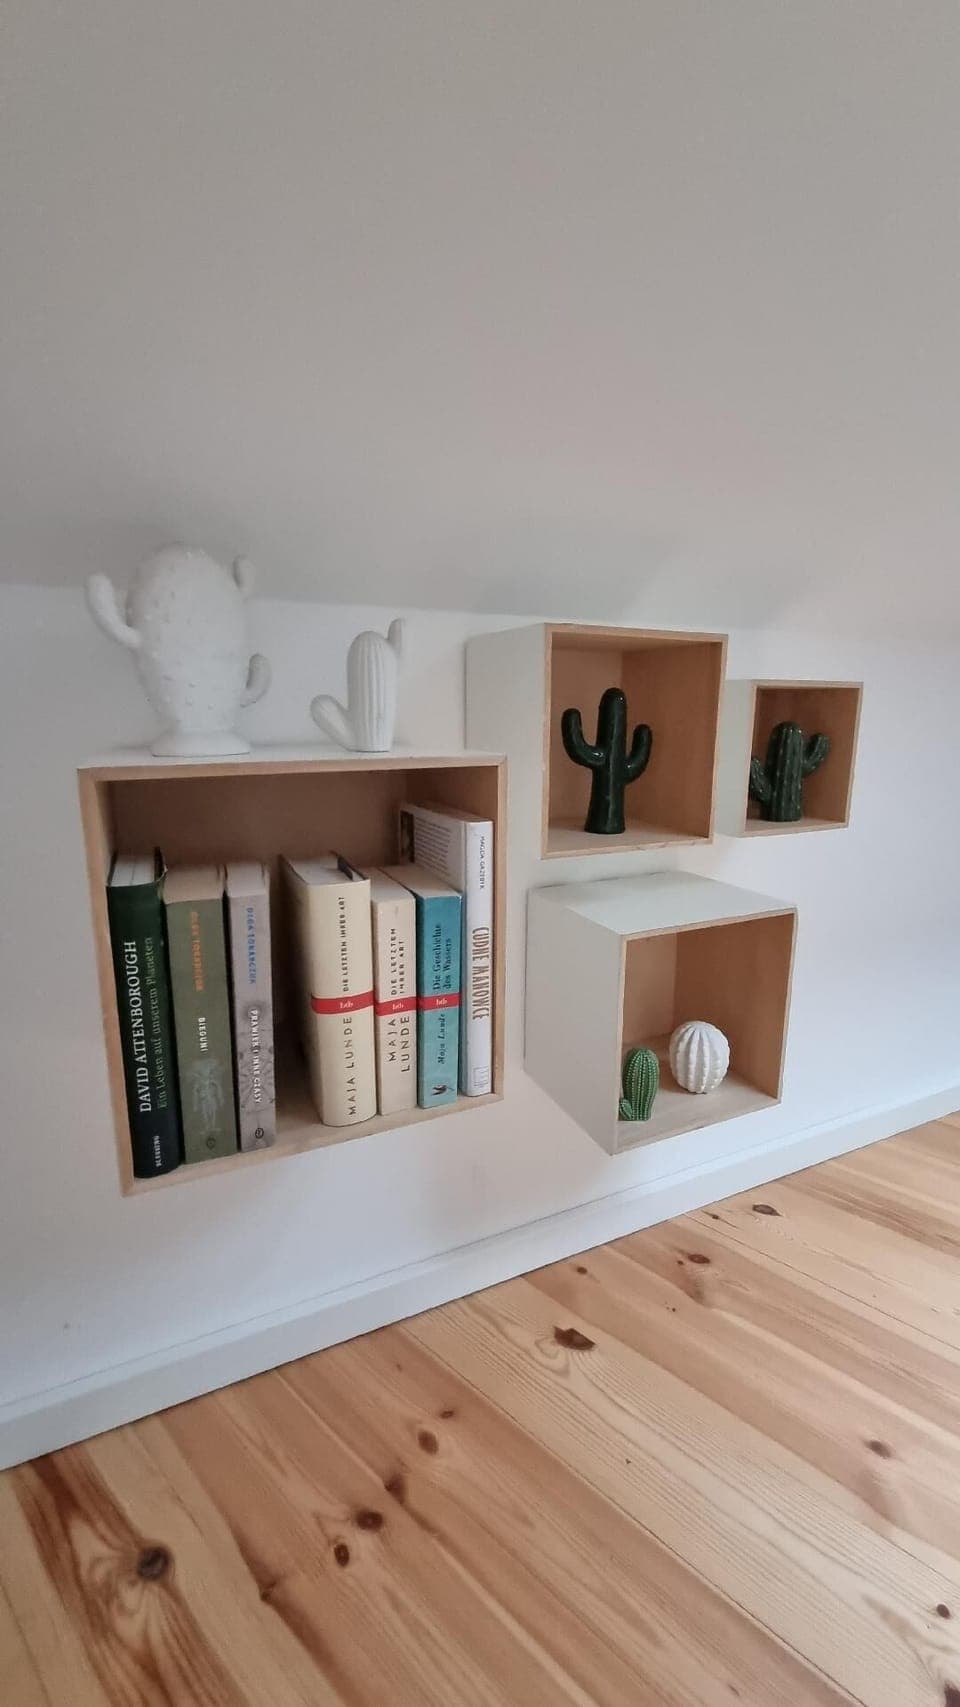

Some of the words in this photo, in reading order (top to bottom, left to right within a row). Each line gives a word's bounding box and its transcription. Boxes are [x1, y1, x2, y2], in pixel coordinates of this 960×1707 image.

[246, 907, 254, 931] OLGA
[339, 914, 347, 938] IHRER
[144, 937, 157, 985] Planeten
[340, 941, 348, 976] LETZTEN
[431, 924, 442, 972] Geschichte
[442, 938, 453, 972] Wassers
[471, 926, 490, 961] CUDNE
[432, 974, 441, 990] Die
[443, 974, 452, 990] des
[471, 966, 490, 1020] MANOWCE
[123, 940, 148, 1064] ATTENBOROUGH
[149, 987, 161, 1034] unserem
[198, 1017, 209, 1053] BIEGUNI
[342, 1016, 355, 1069] LUNDE
[387, 1018, 398, 1062] MAJA
[437, 1013, 446, 1040] Lunde
[151, 1038, 163, 1055] auf
[400, 1016, 411, 1073] LUNDE
[437, 1043, 447, 1065] Maja
[136, 1067, 152, 1112] DAVID
[153, 1058, 166, 1089] Leben
[157, 1091, 168, 1109] Ein
[346, 1077, 357, 1116] MAJA
